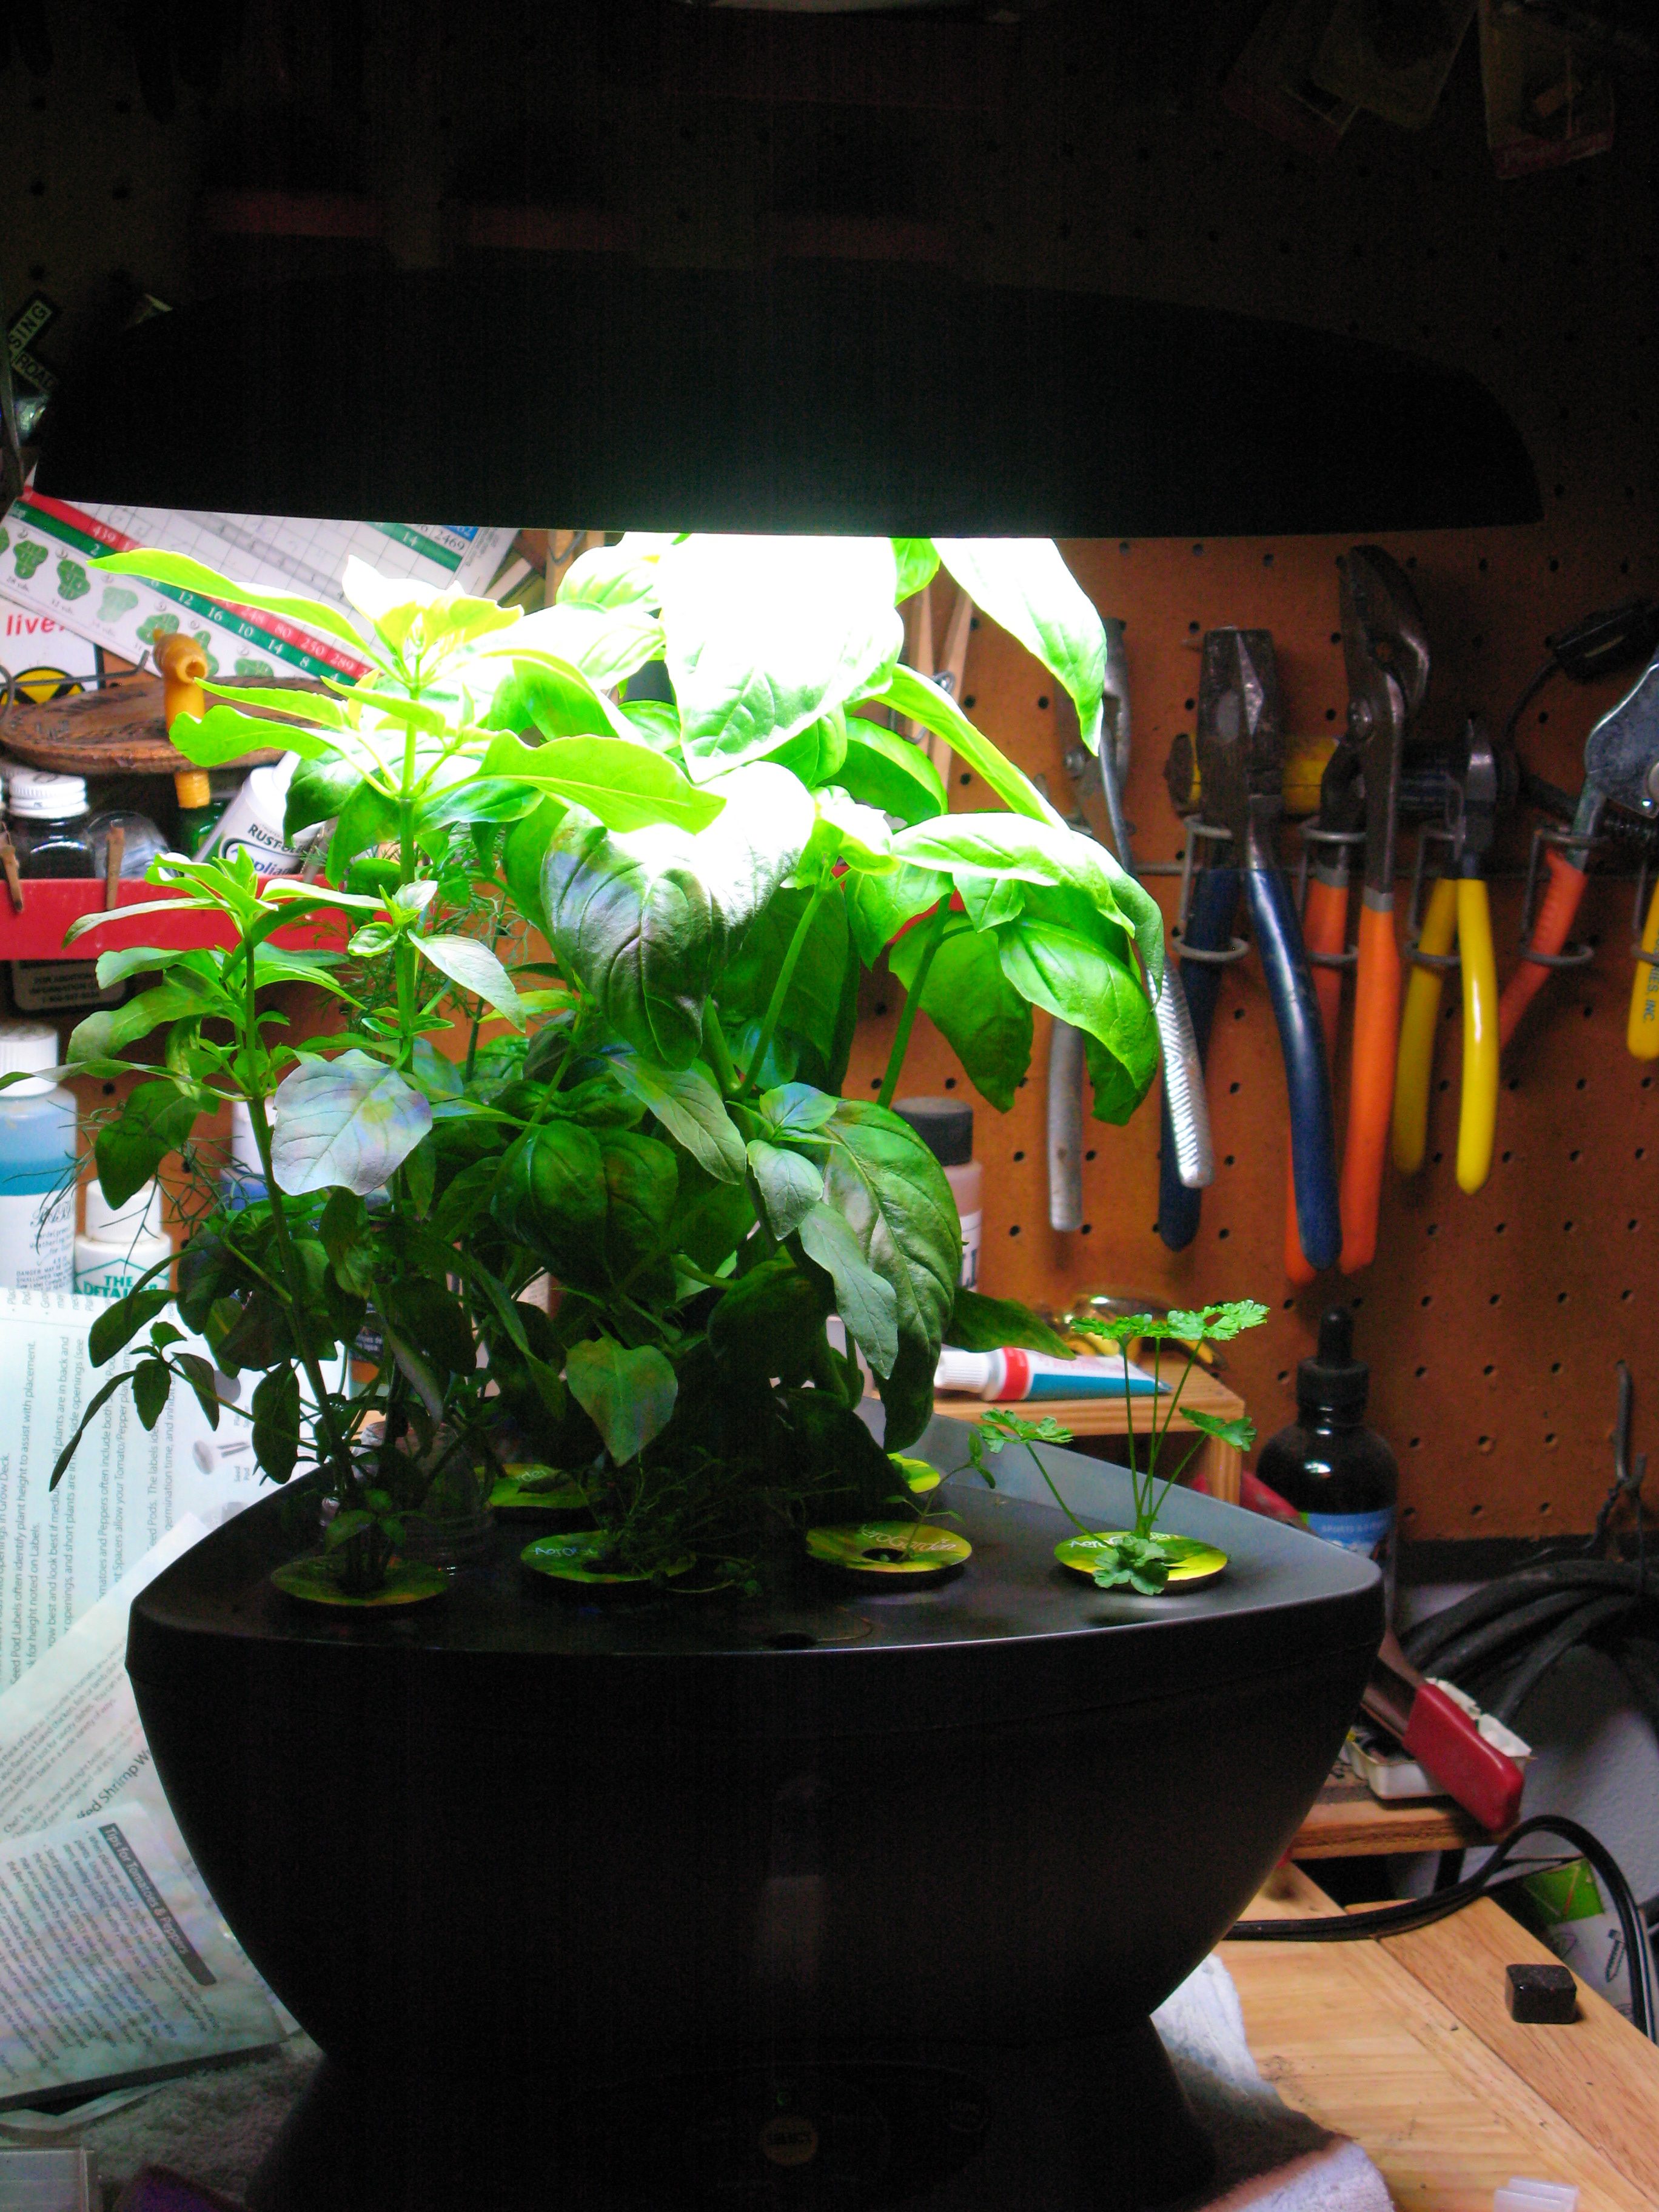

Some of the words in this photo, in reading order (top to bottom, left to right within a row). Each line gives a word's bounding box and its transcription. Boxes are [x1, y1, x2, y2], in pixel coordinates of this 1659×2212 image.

[91, 524, 117, 545] 439
[401, 530, 420, 548] 14
[434, 528, 466, 554] 2469
[89, 542, 101, 556] 2
[176, 589, 195, 606] 12
[206, 605, 225, 623] 16
[236, 621, 255, 639] 10
[266, 637, 285, 655] 14
[298, 655, 310, 669] 8
[300, 636, 327, 660] 250
[104, 1275, 133, 1287] THE
[58, 1335, 70, 1356] and
[73, 1338, 84, 1359] (see
[22, 1340, 38, 1398] placement.
[56, 1357, 68, 1382] back
[56, 1384, 65, 1394] in
[71, 1361, 85, 1410] openings
[20, 1399, 32, 1423] with
[56, 1395, 65, 1412] are
[68, 1411, 79, 1432] side
[101, 1405, 112, 1429] both
[19, 1425, 30, 1452] assist
[52, 1415, 65, 1446] plants
[113, 1405, 129, 1480] Tomato/Pepper
[164, 1422, 173, 1441] and
[19, 1454, 28, 1465] to
[99, 1430, 111, 1467] include
[147, 1446, 158, 1474] labels
[164, 1444, 174, 1468] time,
[0, 1452, 10, 1480] Deck.
[67, 1462, 76, 1472] in
[16, 1467, 29, 1501] height
[67, 1473, 75, 1490] are
[98, 1469, 110, 1495] often
[115, 1482, 126, 1504] your
[147, 1476, 158, 1495] The
[14, 1504, 27, 1530] plant
[63, 1492, 77, 1523] plants
[97, 1497, 112, 1536] Peppers
[112, 1507, 124, 1532] allow
[146, 1499, 158, 1526] Pods.
[12, 1532, 26, 1571] identify
[28, 1522, 40, 1557] Labels.
[47, 1533, 59, 1555] best
[62, 1530, 73, 1551] short
[96, 1538, 107, 1556] and
[112, 1533, 126, 1570] Spacers
[30, 1559, 39, 1573] on
[46, 1557, 58, 1580] look
[62, 1553, 73, 1574] and
[11, 1573, 23, 1600] often
[26, 1575, 39, 1605] noted
[46, 1581, 58, 1601] and
[62, 1575, 75, 1624] openings,
[10, 1602, 22, 1635] Labels
[25, 1607, 41, 1641] height
[45, 1603, 57, 1625] best
[10, 1637, 21, 1657] Pod
[25, 1643, 37, 1657] for
[99, 1763, 139, 1804] Shrimp
[104, 1828, 121, 1847] Tips
[118, 1847, 132, 1863] for
[127, 1863, 159, 1907] Tomatoes
[155, 1907, 165, 1916] &
[159, 1917, 188, 1955] Peppers
